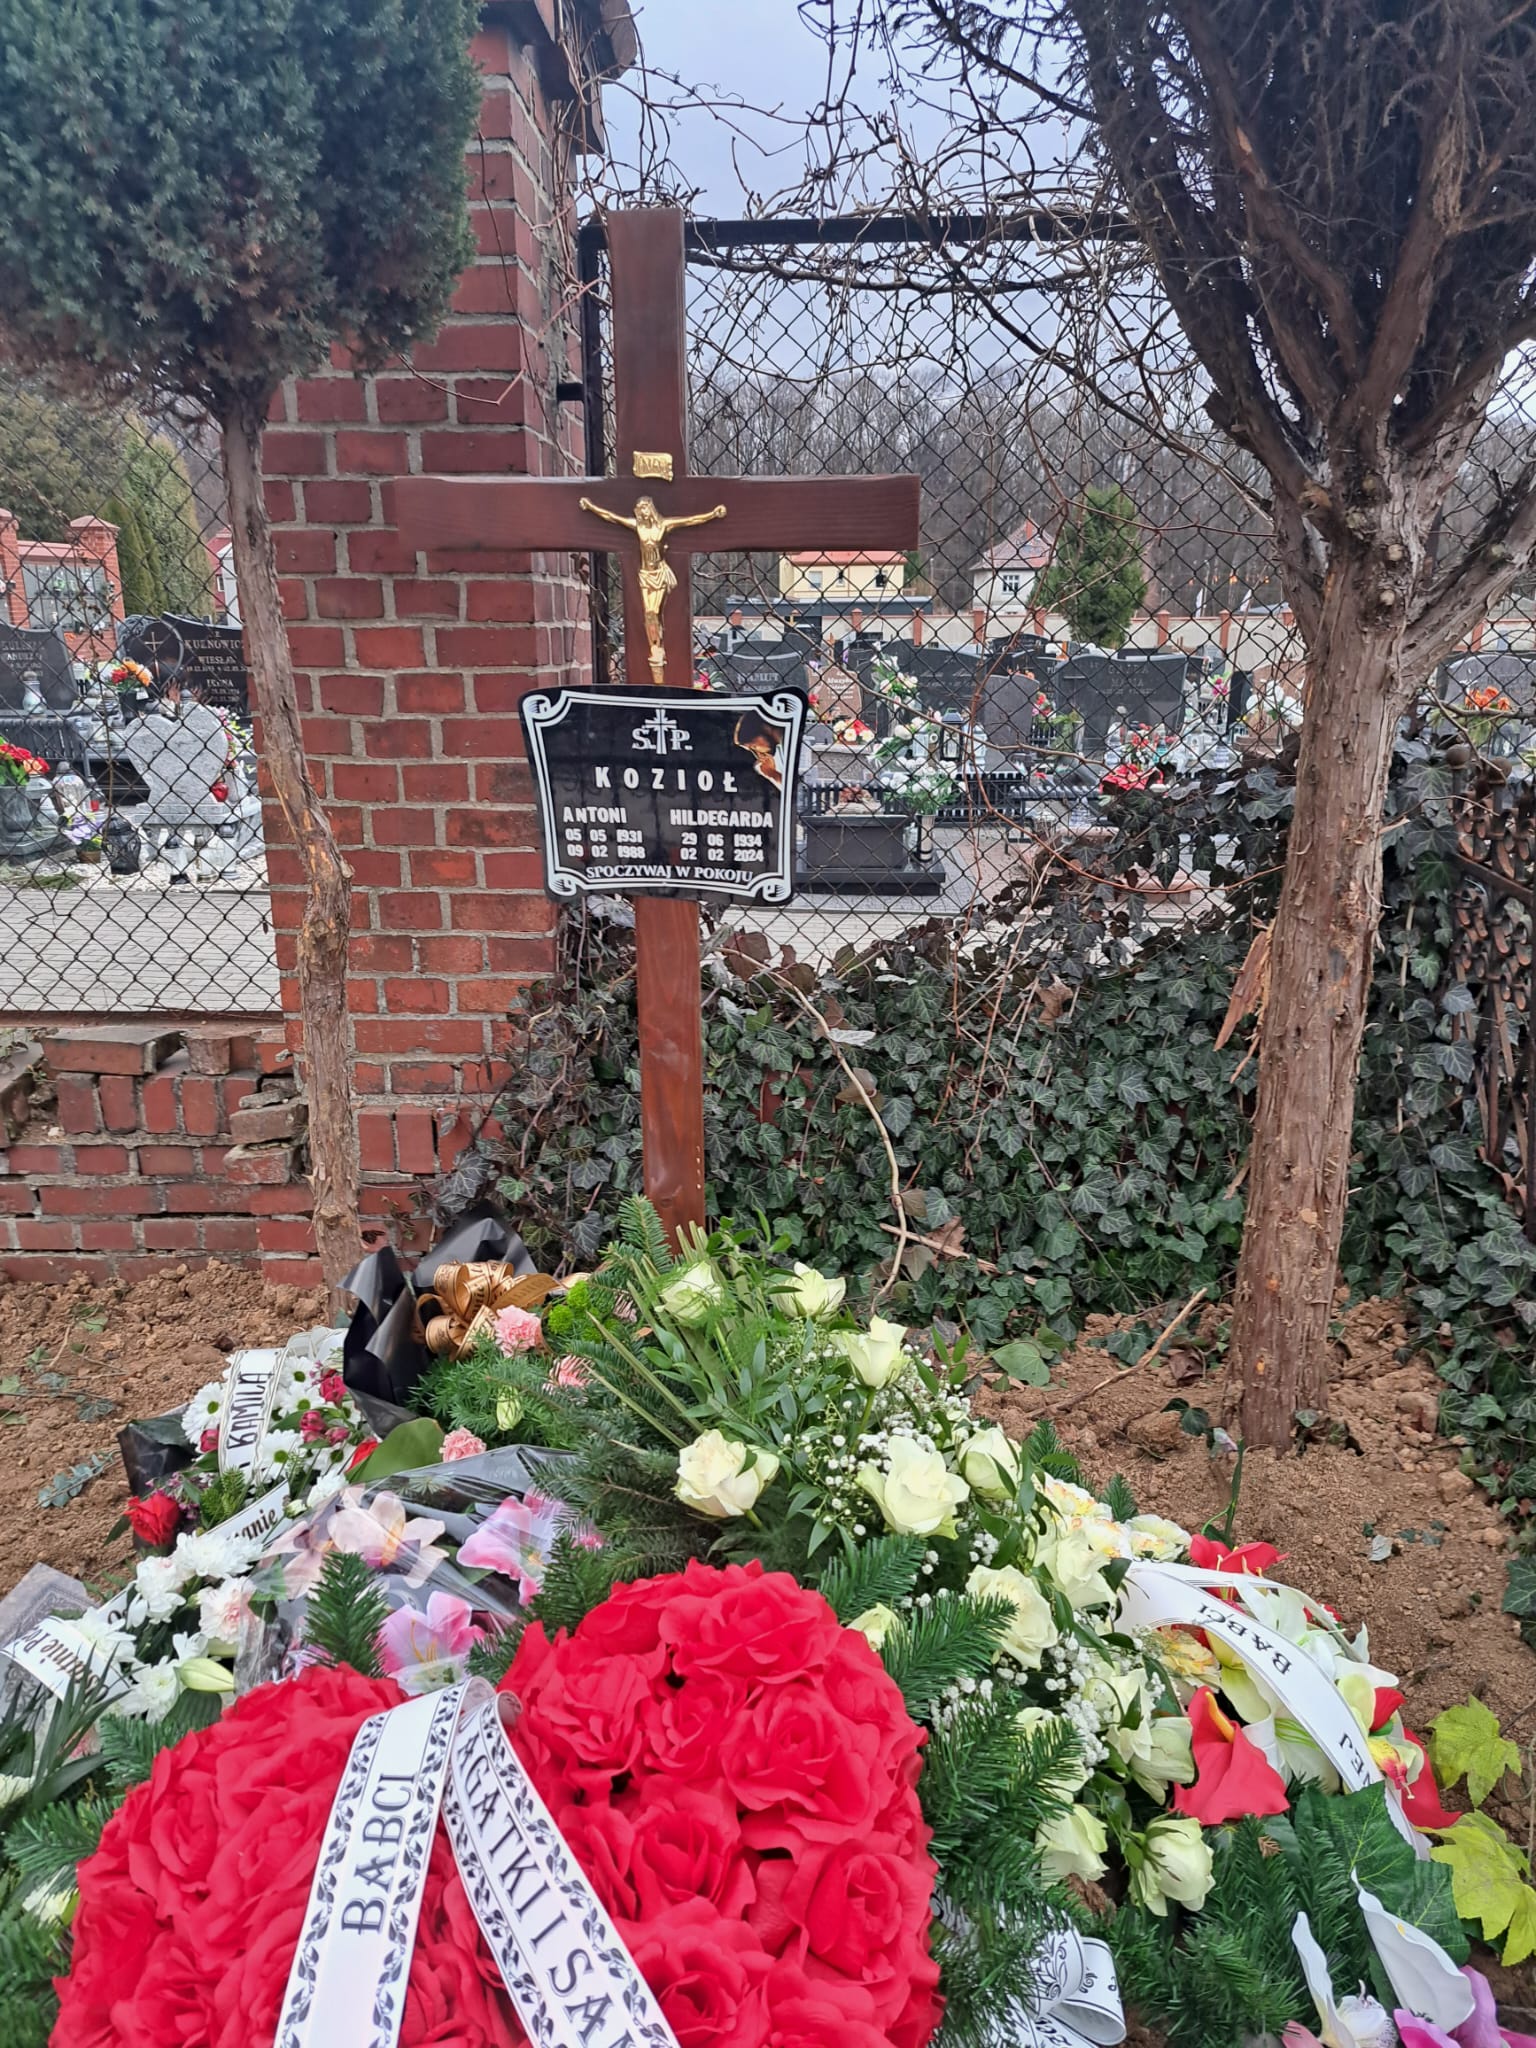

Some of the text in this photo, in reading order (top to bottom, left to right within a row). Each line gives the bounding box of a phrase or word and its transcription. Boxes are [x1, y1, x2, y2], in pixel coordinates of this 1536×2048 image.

[594, 766, 738, 793] KOZIOŁ
[563, 806, 627, 823] ANTONI
[669, 809, 774, 828] HILDEGARDA
[565, 828, 643, 843] 05 05 1931
[681, 832, 763, 848] 29 06 1934
[591, 845, 608, 858] 02
[616, 845, 646, 859] 1988
[680, 848, 765, 864] 02 02 2024
[585, 864, 753, 884] SPOCZYWAJ W POKOJU
[1197, 1603, 1293, 1676] BABCI
[341, 1773, 417, 1936] BABCI
[457, 1732, 551, 1922] AGATKI
[547, 1947, 636, 2048] SA
